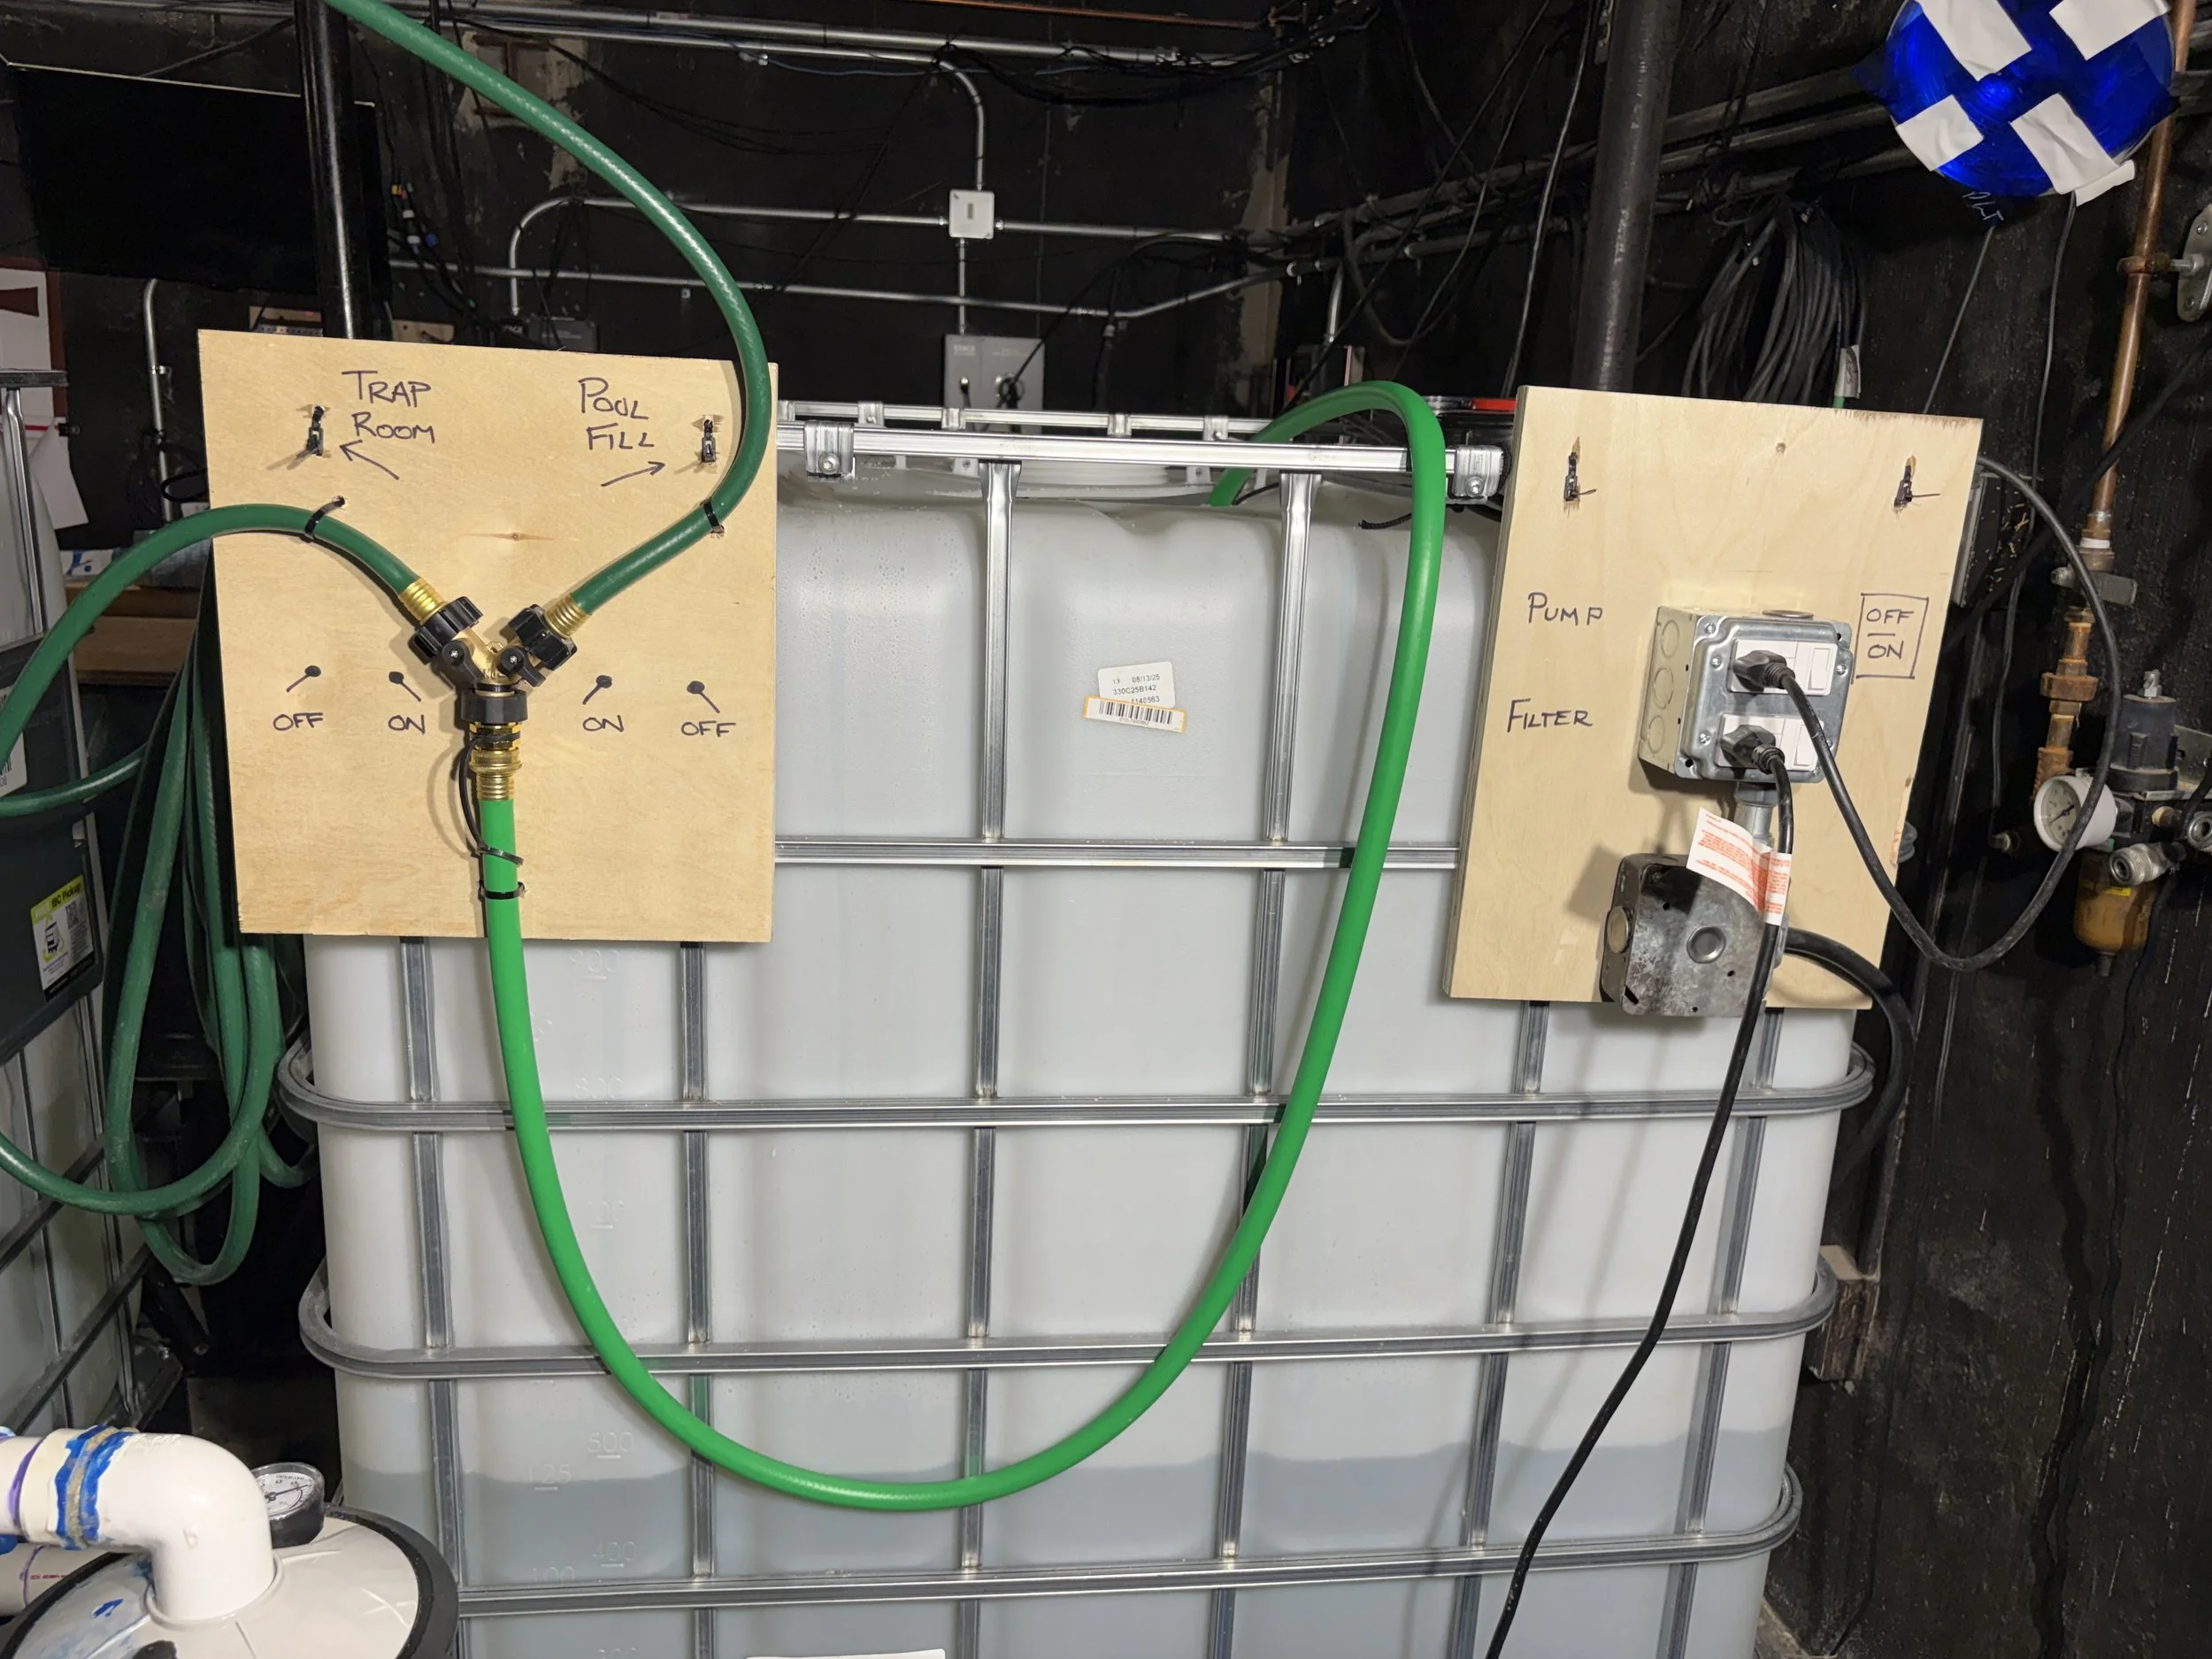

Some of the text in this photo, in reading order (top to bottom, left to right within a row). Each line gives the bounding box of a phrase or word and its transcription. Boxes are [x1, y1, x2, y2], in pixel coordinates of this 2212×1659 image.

[341, 370, 432, 408] TRAP
[578, 377, 649, 420] POOL
[351, 411, 435, 443] ROOM
[586, 422, 655, 450] FILL
[1527, 591, 1603, 626] PUMP
[1866, 608, 1915, 625] OFF
[1867, 640, 1904, 660] ON
[273, 711, 324, 732] OFF
[388, 714, 426, 735] ON
[582, 714, 625, 733] ON
[1507, 697, 1594, 733] FILTER
[680, 719, 737, 738] OFF
